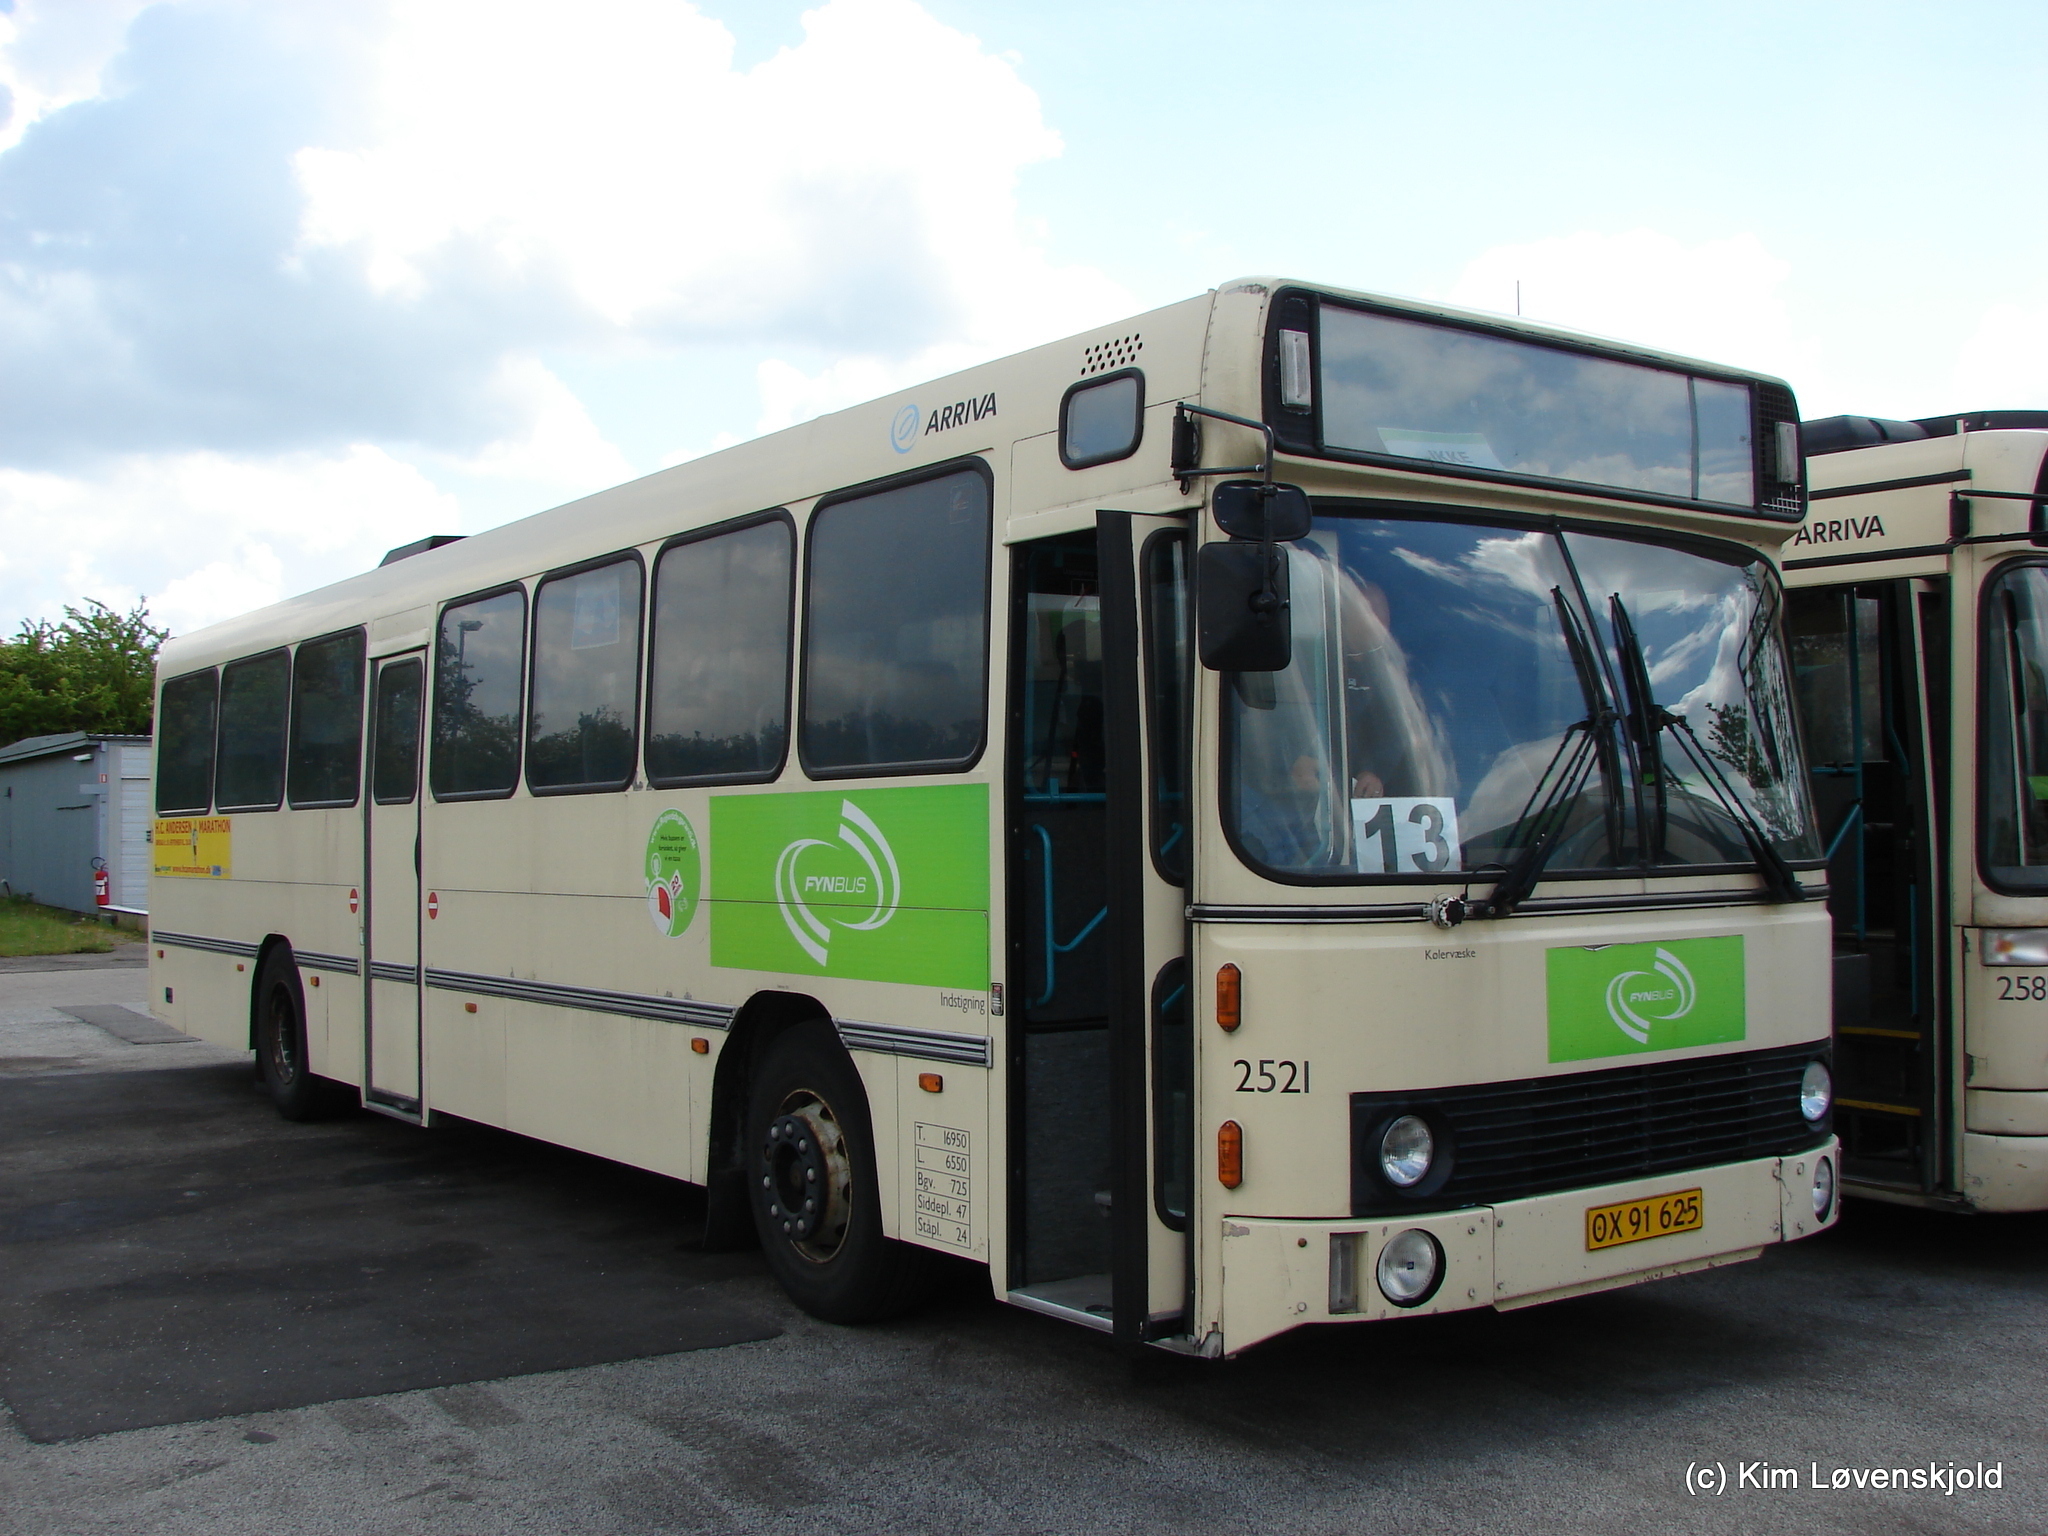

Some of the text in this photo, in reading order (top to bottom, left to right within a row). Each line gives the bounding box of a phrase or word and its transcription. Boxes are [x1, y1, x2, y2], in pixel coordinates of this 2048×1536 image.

[924, 392, 997, 436] ARRIVA
[1428, 450, 1474, 464] IKKE
[1793, 515, 1885, 546] ARRIVA
[166, 820, 192, 834] ANDERSEN
[198, 819, 231, 834] MARATHON
[1364, 803, 1450, 873] 13
[805, 876, 867, 893] FYNBUS
[1629, 989, 1675, 1003] FYNBUS
[1996, 976, 2046, 1001] 258
[940, 992, 986, 1015] Indstigning
[1233, 1059, 1310, 1094] 2521
[916, 1125, 967, 1148] T. 16950
[917, 1148, 967, 1172] L. 6550
[917, 1172, 967, 1196] Bgv. 725
[917, 1194, 967, 1219] Siddepl. 47
[917, 1217, 967, 1243] Ståpl. 24
[1592, 1196, 1698, 1242] OX 91 625
